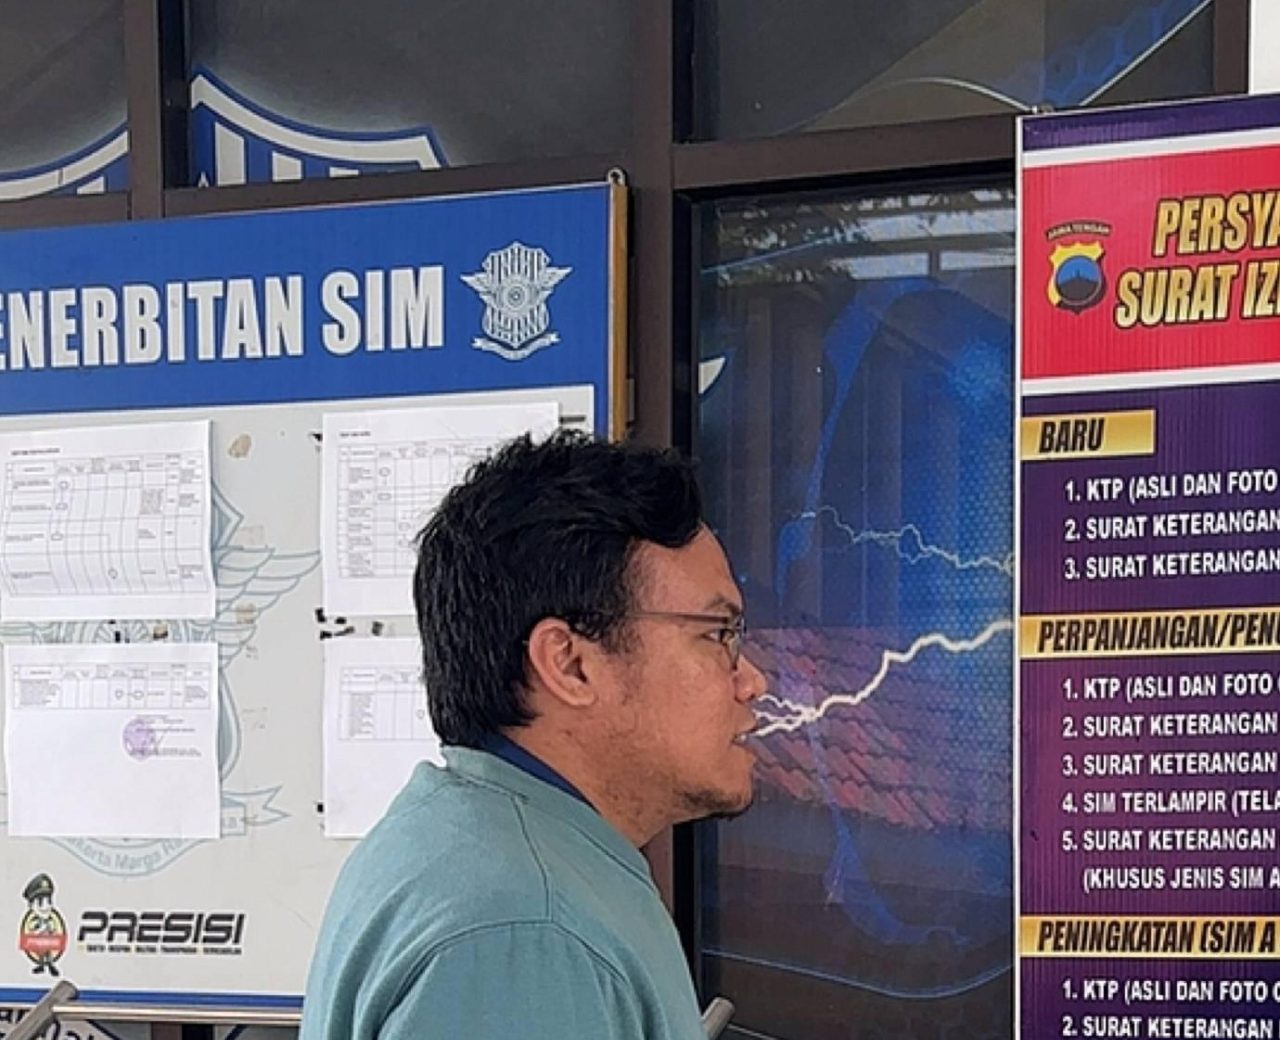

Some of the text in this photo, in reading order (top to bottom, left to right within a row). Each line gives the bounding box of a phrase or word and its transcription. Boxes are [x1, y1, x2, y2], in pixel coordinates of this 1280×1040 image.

[1115, 267, 1238, 329] SURAT
[321, 265, 445, 361] SIM
[1038, 417, 1106, 454] BARU
[1065, 480, 1081, 501] 1.
[1086, 478, 1124, 501] KTP
[1129, 475, 1177, 505] (ASLI
[1183, 472, 1221, 497] DAN
[1227, 469, 1278, 494] FOTO
[1065, 518, 1081, 541] 2.
[1086, 515, 1148, 540] SURAT
[1064, 557, 1081, 580] 3.
[1086, 554, 1147, 579] SURAT
[1063, 678, 1078, 699] 1.
[1084, 677, 1121, 699] KTP
[1126, 676, 1173, 703] (ASLI
[1179, 674, 1217, 697] DAN
[1223, 672, 1273, 696] FOTO
[1062, 716, 1078, 737] 2.
[1083, 715, 1145, 737] SURAT
[1150, 712, 1278, 736] KETERANGAN
[1062, 754, 1078, 776] 3.
[1083, 754, 1144, 776] SURAT
[1150, 751, 1278, 775] KETERANGAN
[1062, 792, 1078, 813] 4.
[1083, 792, 1116, 813] SIM
[1121, 790, 1227, 813] TERLAMPIR
[1062, 830, 1078, 851] 5.
[1083, 830, 1143, 851] SURAT
[1148, 828, 1276, 851] KETERANGAN
[1083, 867, 1166, 894] (KHUSUS
[1170, 866, 1224, 889] JENIS
[1229, 866, 1264, 889] SIM
[77, 910, 246, 944] PRESISI
[1037, 920, 1197, 953] PENINGKATAN
[1199, 920, 1257, 953] (SIM
[1258, 921, 1276, 953] A
